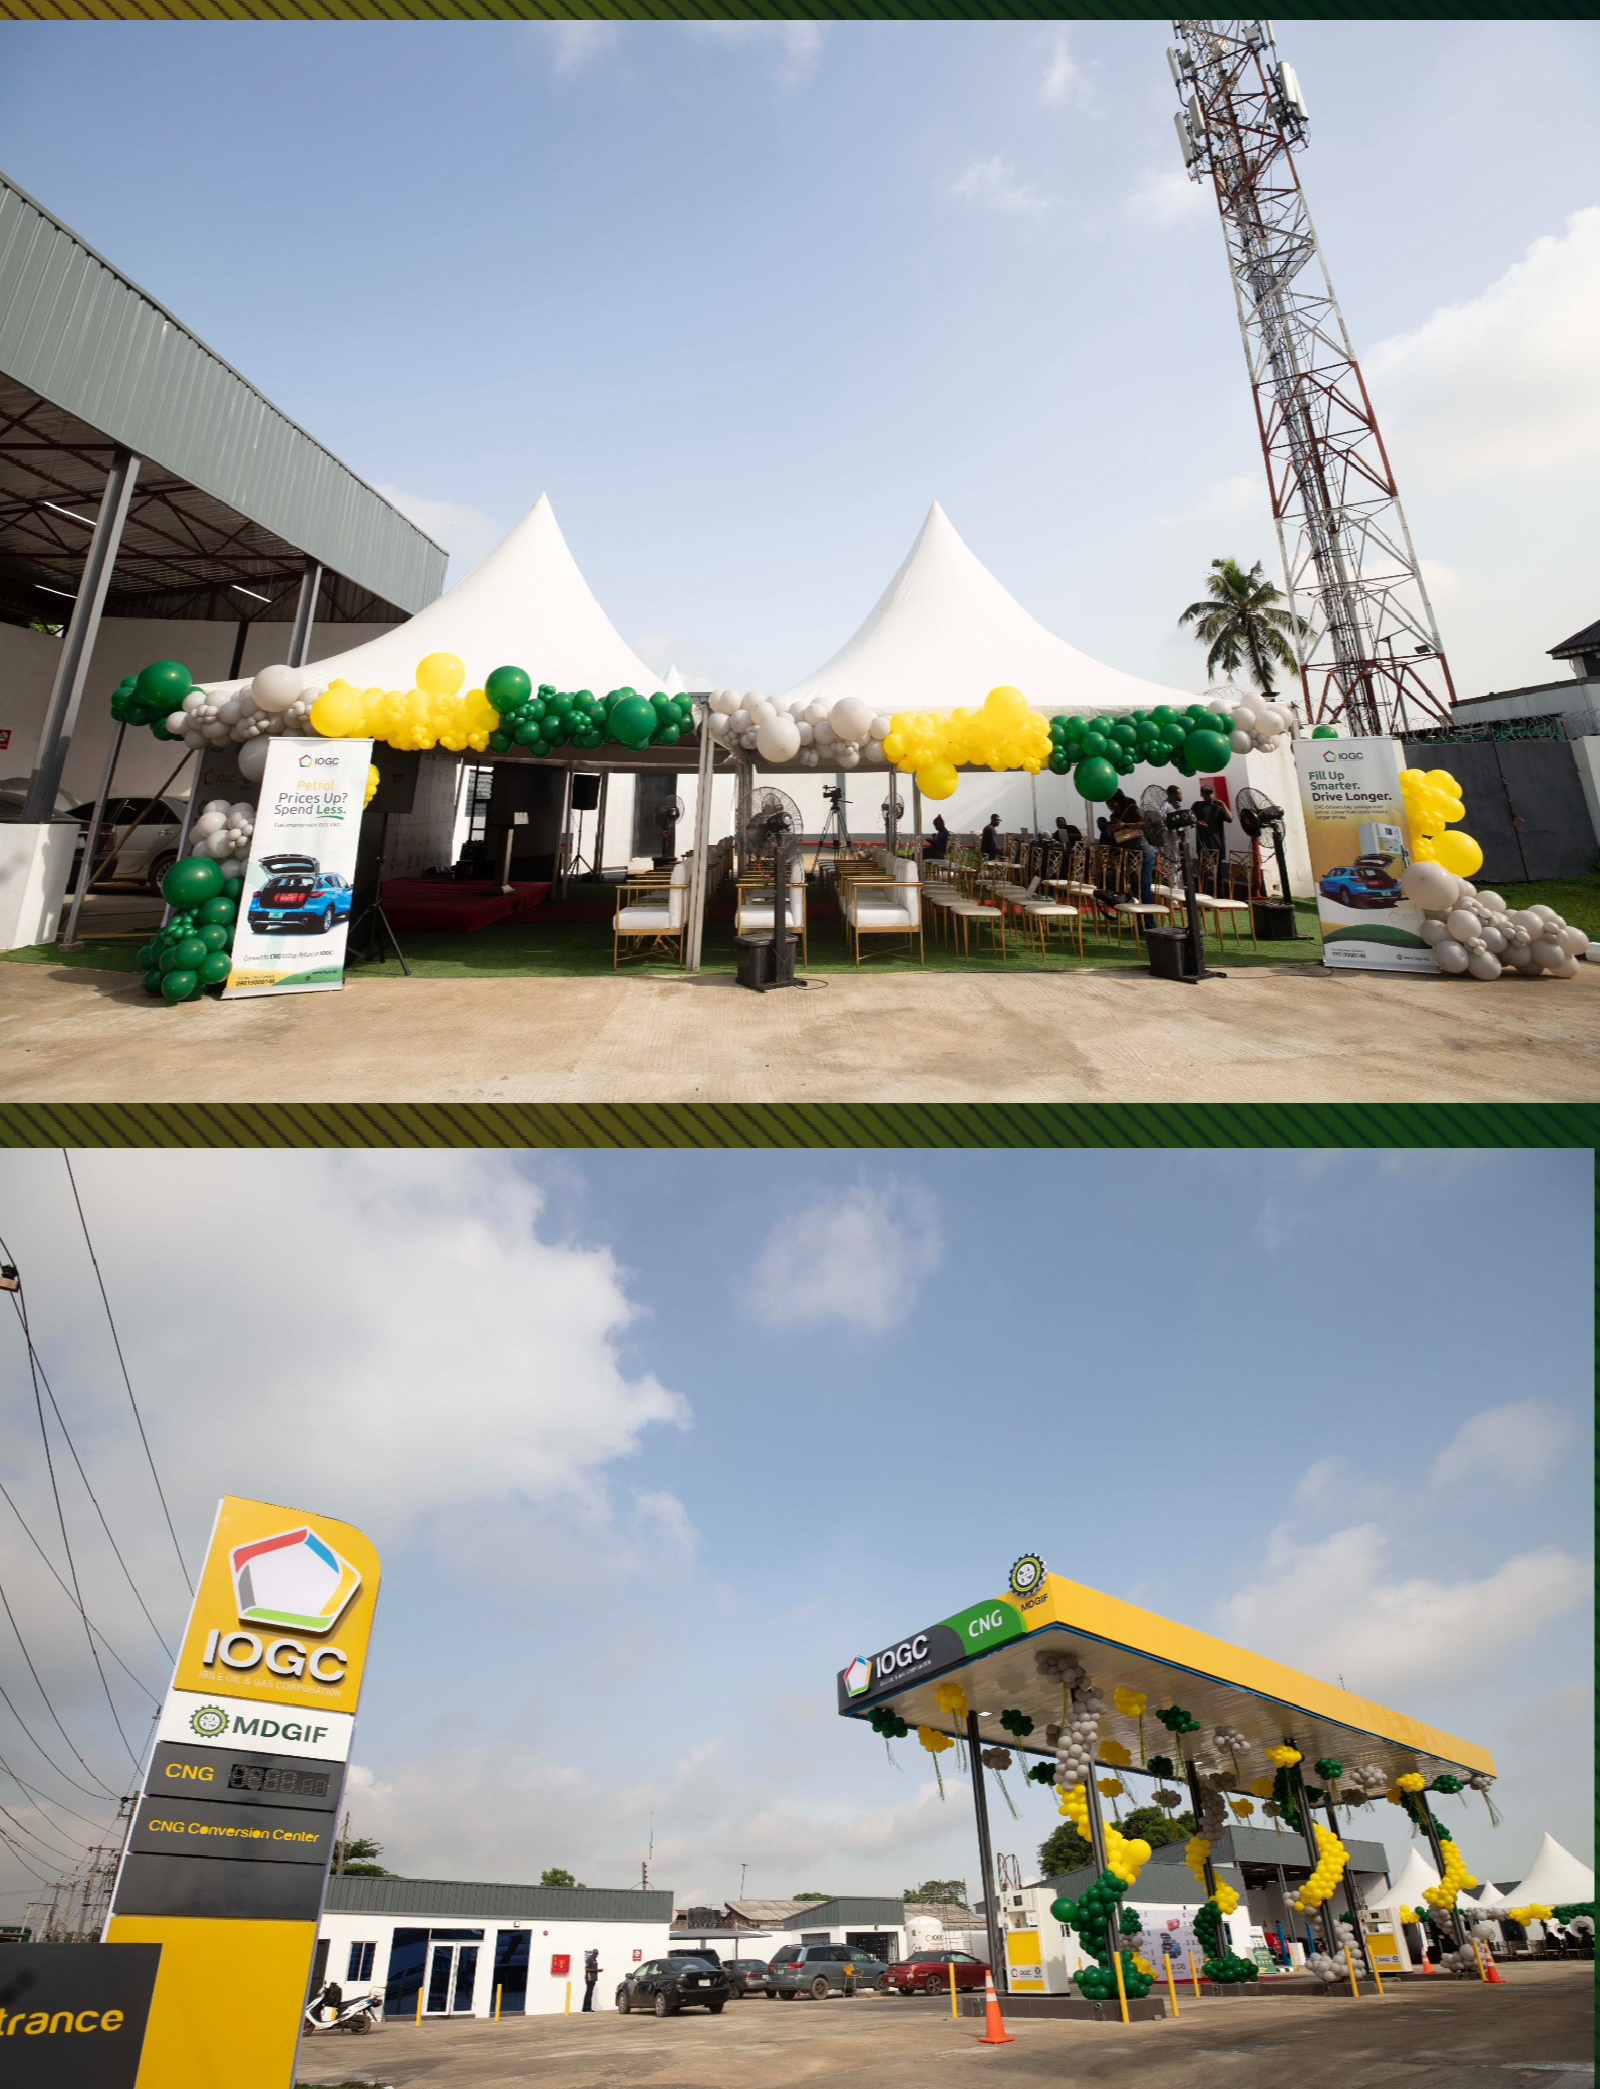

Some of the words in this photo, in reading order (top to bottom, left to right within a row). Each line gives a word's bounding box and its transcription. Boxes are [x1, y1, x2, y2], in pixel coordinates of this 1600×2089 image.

[314, 758, 340, 766] IOGC
[1338, 752, 1364, 760] IOGC
[297, 780, 335, 791] Petrol
[1308, 771, 1326, 780] Fill
[1328, 771, 1345, 782] Up
[1310, 782, 1360, 791] Smarter.
[278, 792, 321, 804] Prices
[323, 792, 349, 806] Up?
[1312, 792, 1343, 802] Drive
[1345, 792, 1392, 803] Longer.
[274, 804, 314, 817] Spend
[316, 804, 346, 815] Less.
[1020, 1593, 1048, 1612] MDGIF
[969, 1609, 1002, 1637] CNG
[203, 1629, 348, 1682] IOGC
[876, 1634, 928, 1678] IOGC
[199, 1670, 225, 1681] IBILE
[226, 1674, 242, 1684] OIL
[244, 1677, 252, 1686] &
[254, 1679, 275, 1688] GAS
[276, 1681, 343, 1698] CORPORATION
[232, 1716, 329, 1744] MDGIF
[165, 1763, 215, 1782] CNG
[149, 1820, 186, 1833] CNG
[188, 1822, 270, 1840] Conversion
[272, 1829, 320, 1843] Center
[0, 2008, 124, 2036] trance
